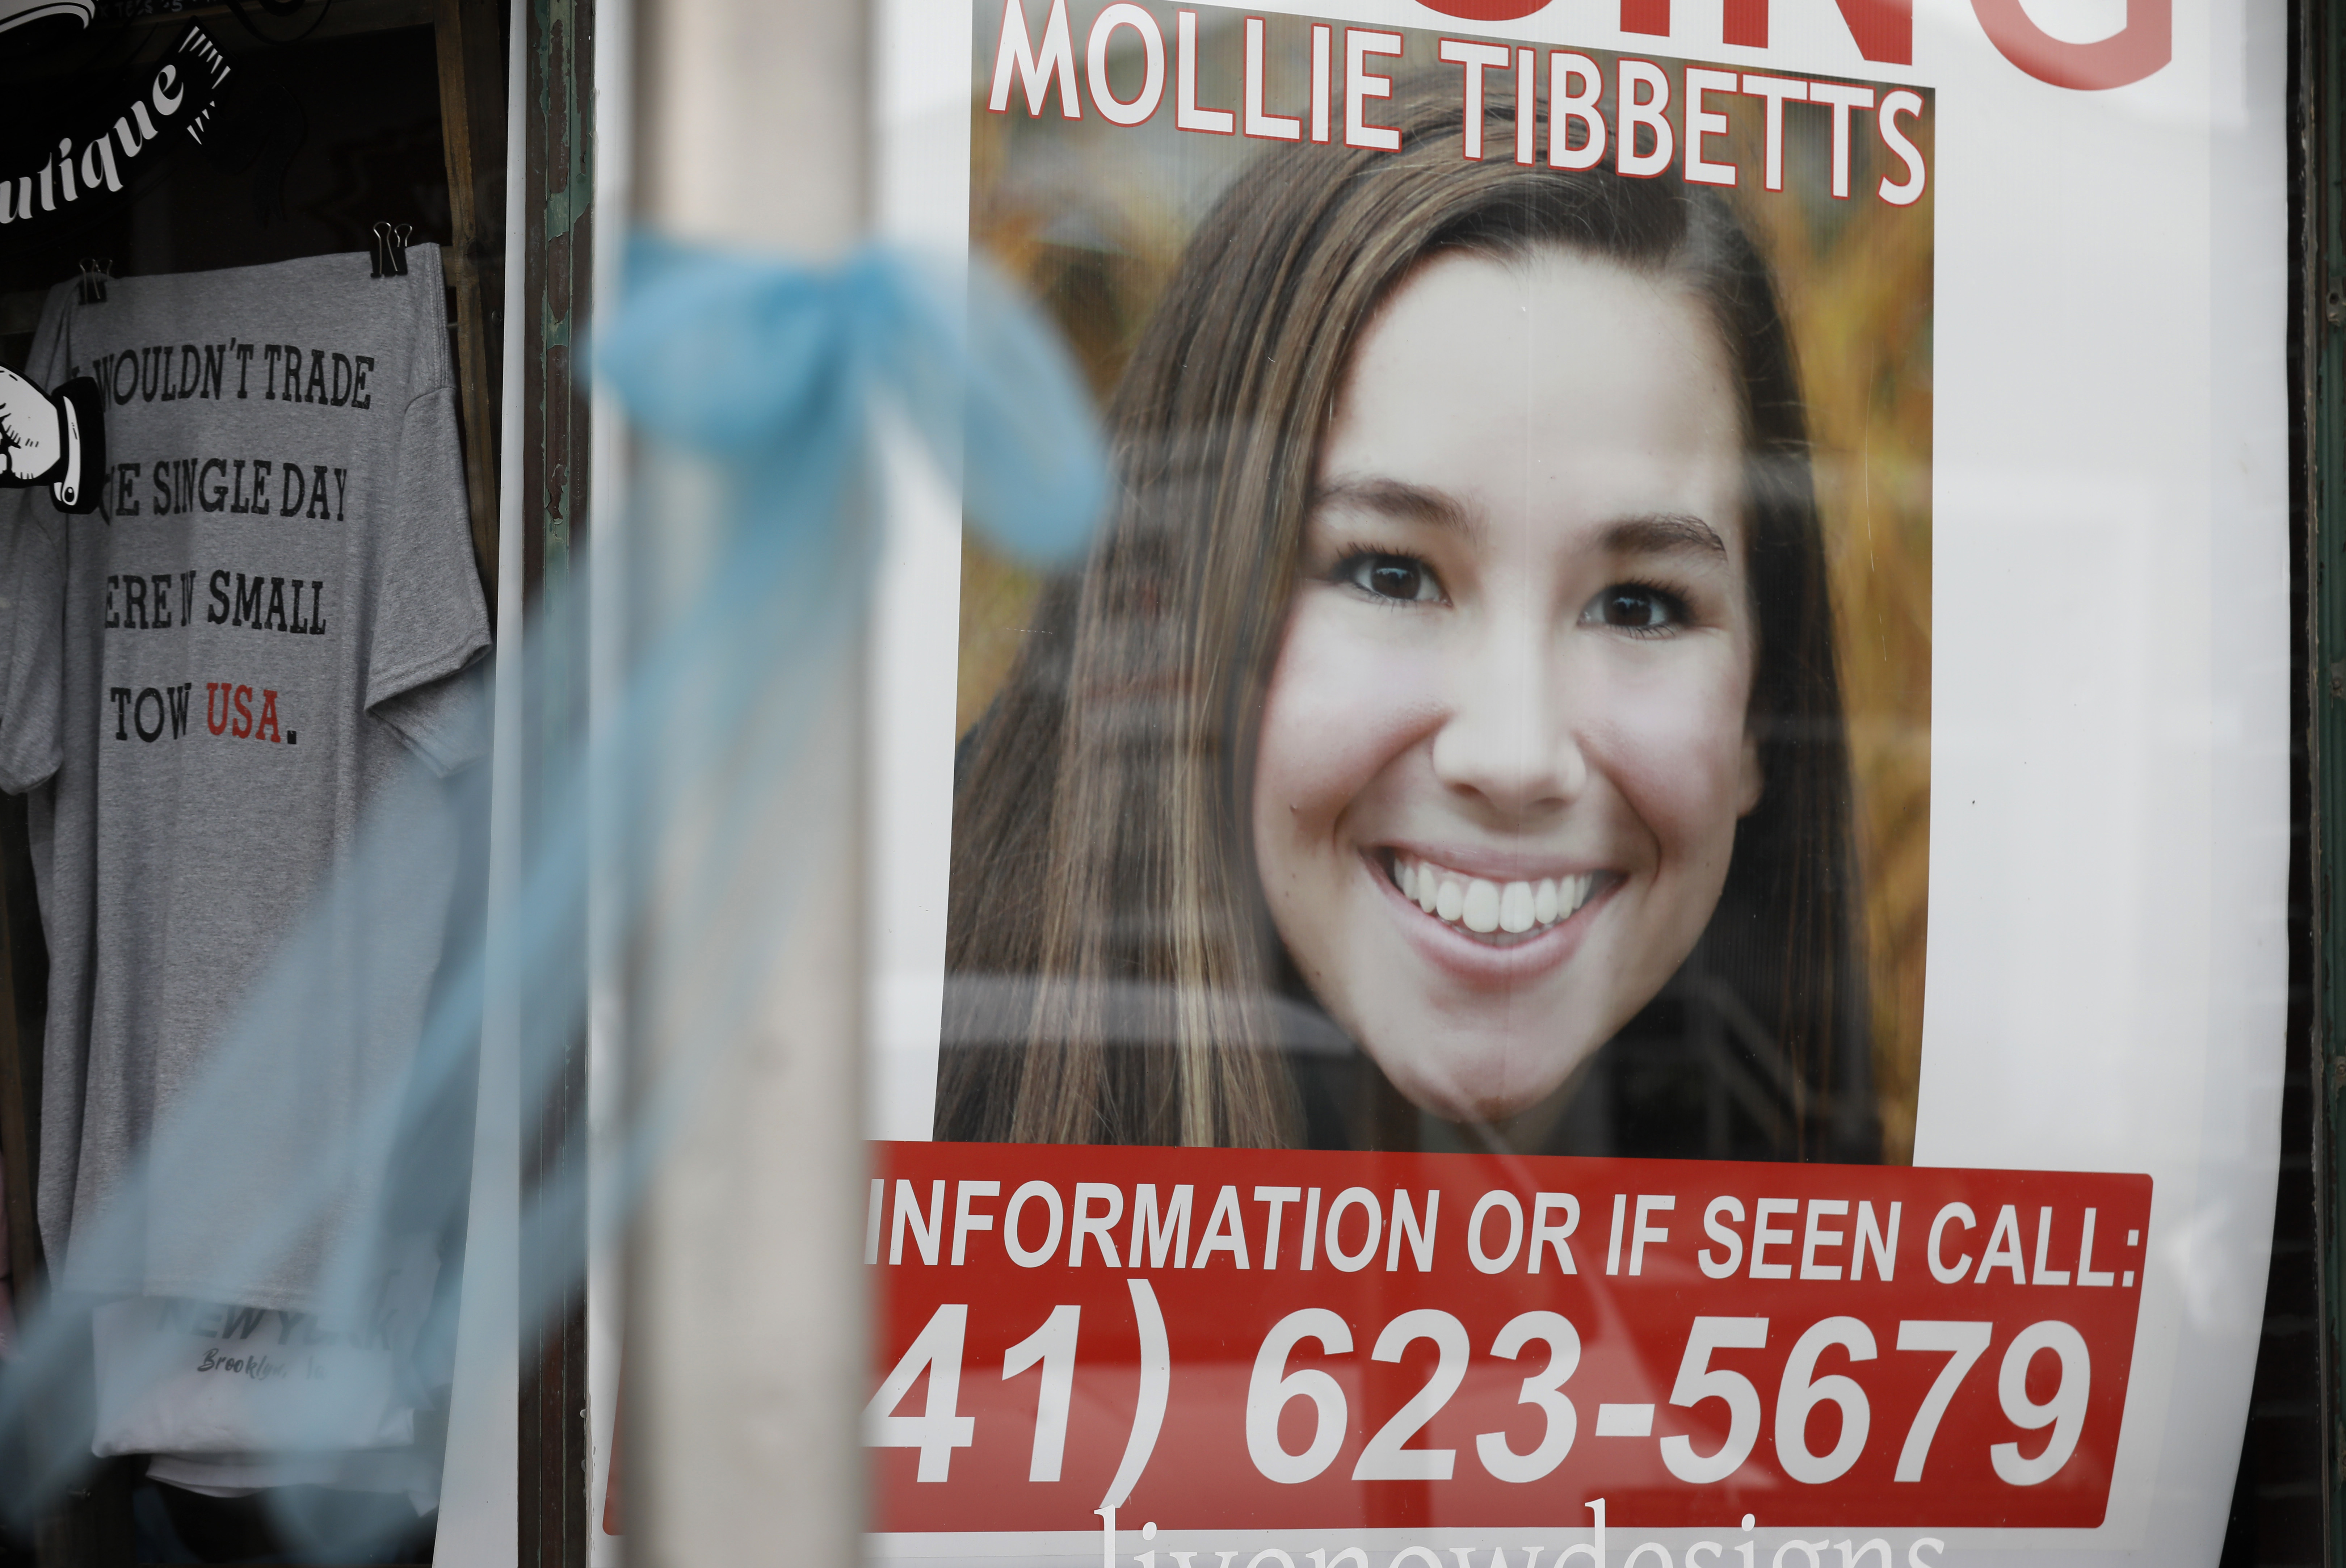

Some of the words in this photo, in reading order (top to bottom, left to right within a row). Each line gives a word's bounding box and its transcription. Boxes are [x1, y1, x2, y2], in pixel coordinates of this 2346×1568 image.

[986, 0, 1404, 152] MOLLIE
[1438, 36, 1928, 207] TIBBETTS
[93, 337, 253, 412] WOULDN'T
[264, 344, 374, 409] TRADE
[153, 458, 271, 516] SINGLE
[281, 463, 347, 521] DAY
[208, 569, 326, 635] SMALL
[206, 682, 297, 744] USA.
[864, 1178, 1439, 1272] INFORMATION
[1467, 1190, 1580, 1274] OR
[1606, 1194, 1676, 1276] IF
[1698, 1195, 1902, 1282] SEEN
[1927, 1201, 2139, 1287] CALL:
[860, 1278, 1170, 1508] 41)
[1245, 1307, 2091, 1486] 623-5679
